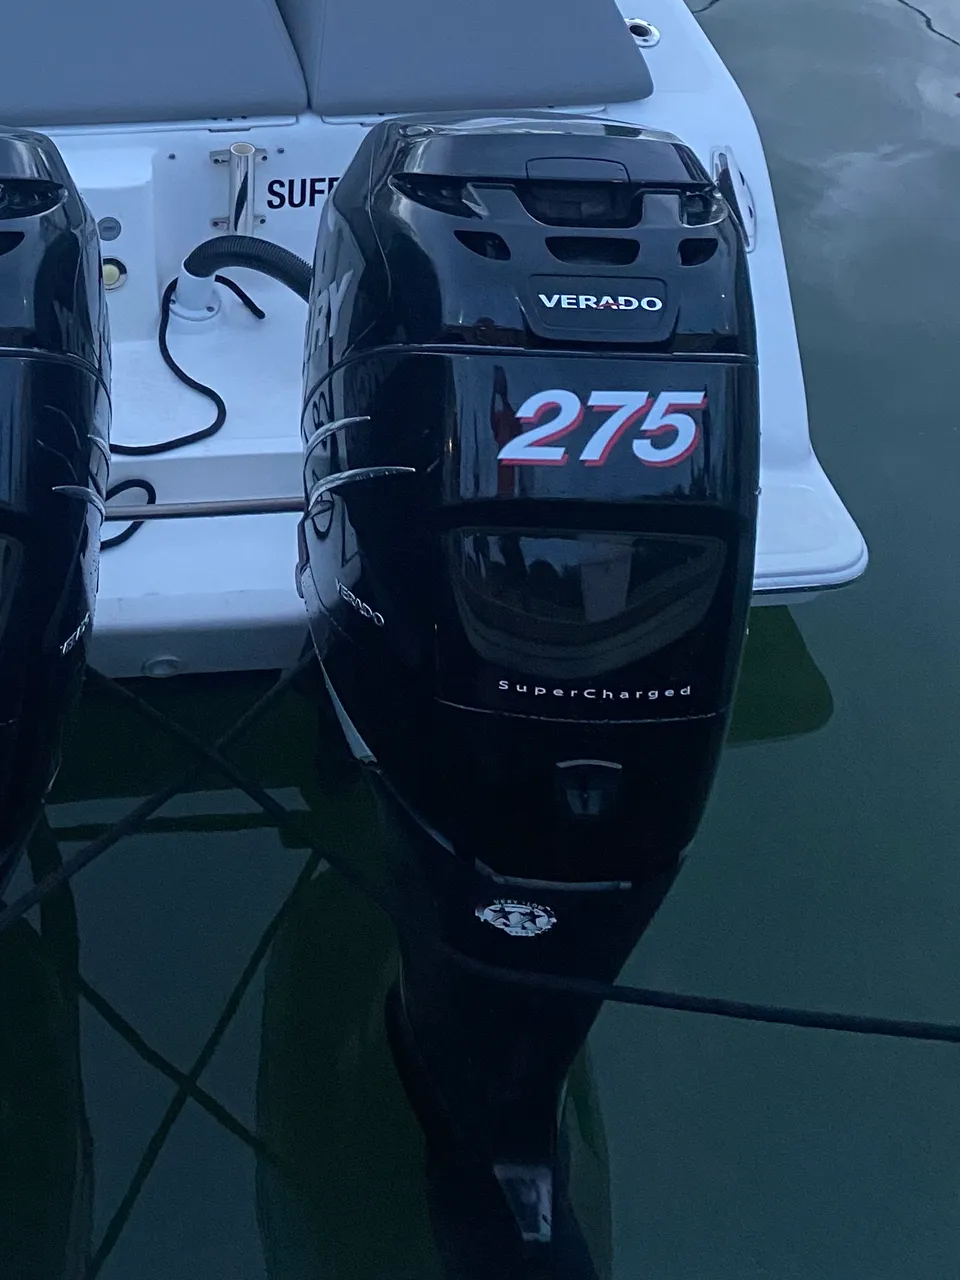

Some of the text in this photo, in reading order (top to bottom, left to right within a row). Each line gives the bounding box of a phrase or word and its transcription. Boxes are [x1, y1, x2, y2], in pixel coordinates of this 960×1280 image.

[538, 293, 664, 312] VERADO
[497, 388, 709, 468] 275
[497, 678, 692, 701] SuperCharged
